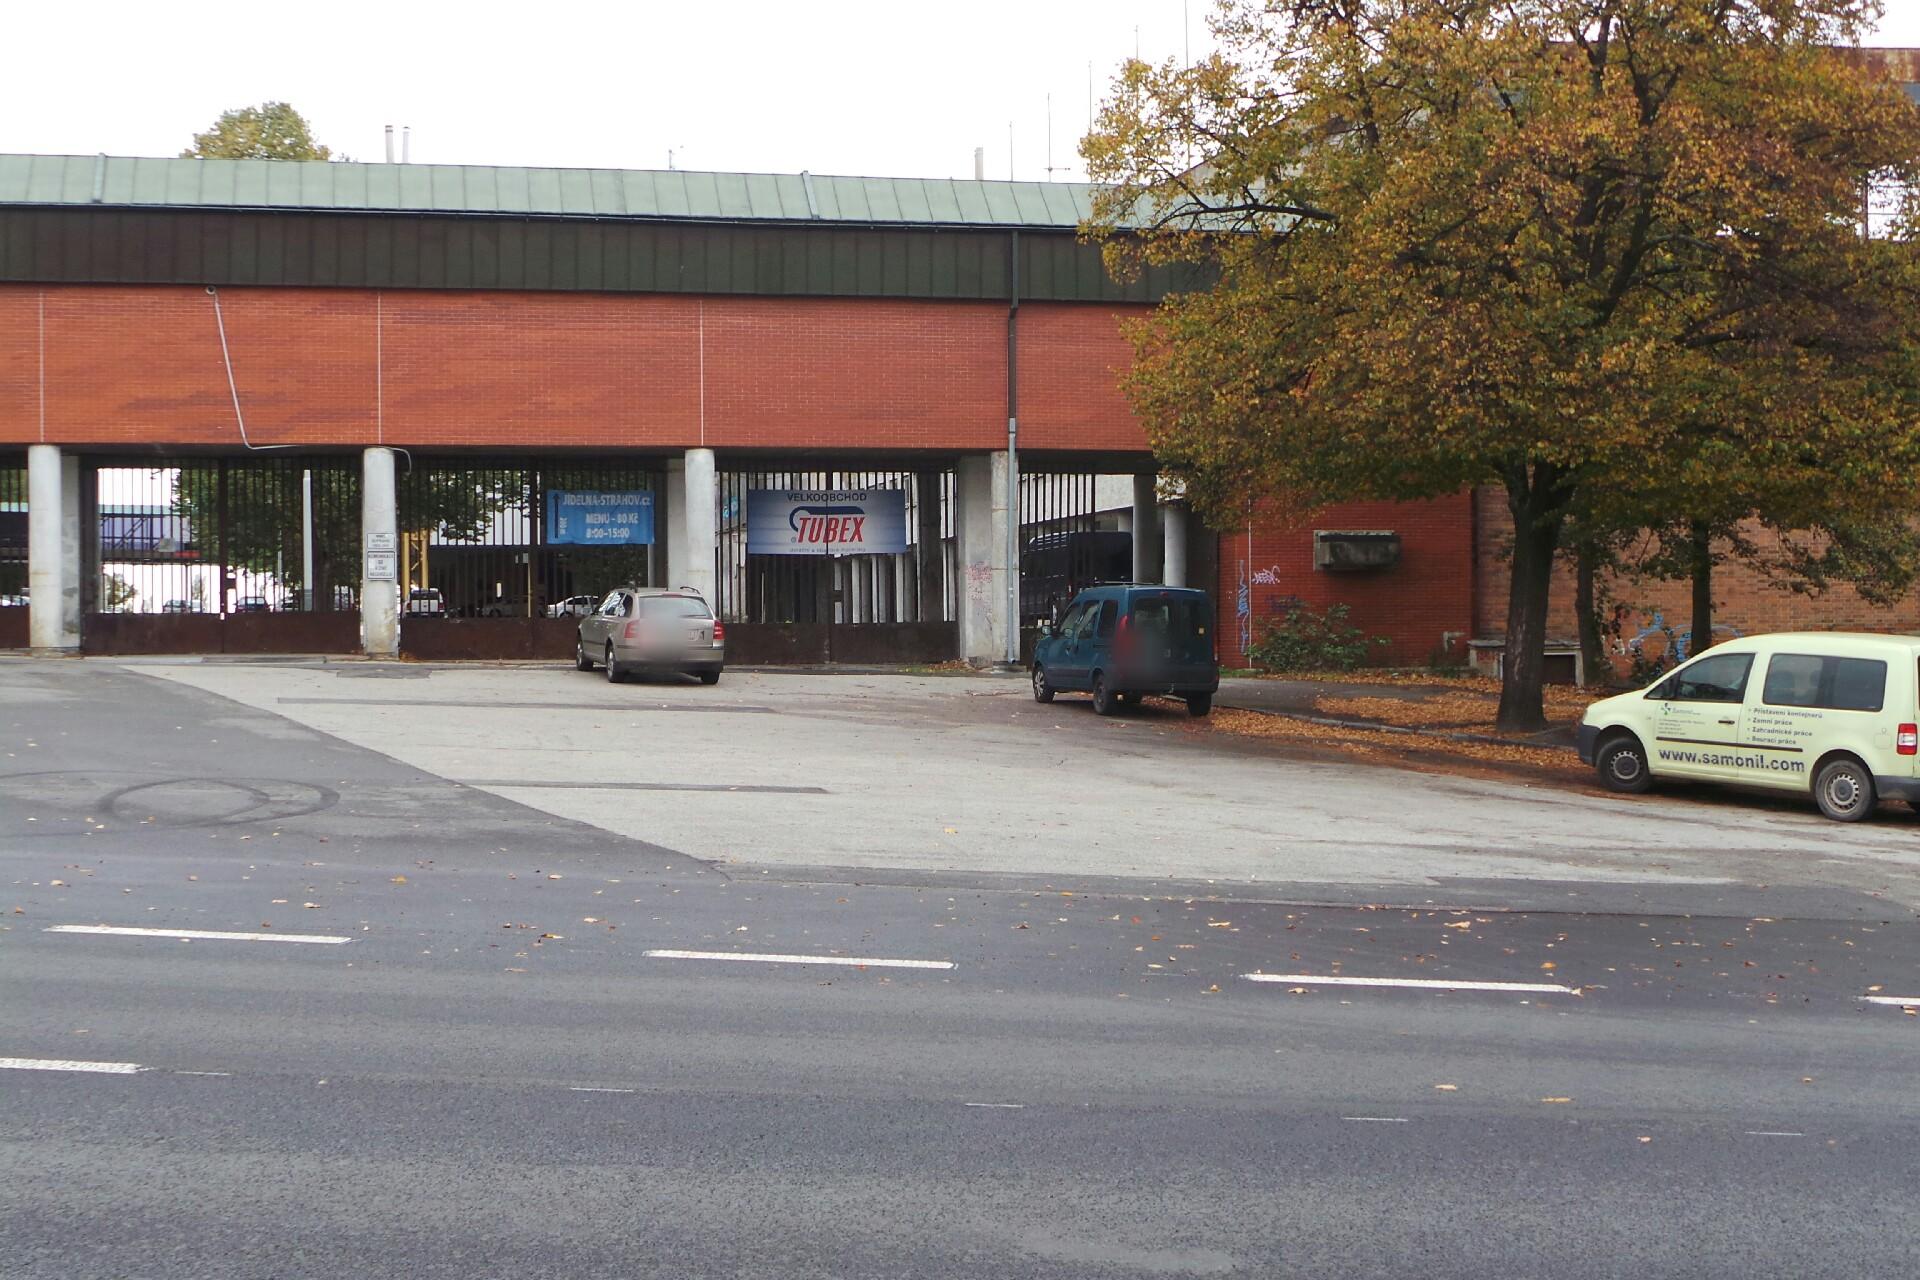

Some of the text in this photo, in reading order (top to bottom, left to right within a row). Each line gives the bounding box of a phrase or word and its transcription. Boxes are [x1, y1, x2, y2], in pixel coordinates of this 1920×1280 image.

[787, 493, 867, 501] VELKOOBCHOD
[585, 513, 610, 524] MENU
[798, 516, 865, 543] TUBEX
[1658, 749, 1805, 772] www.samonil.com
